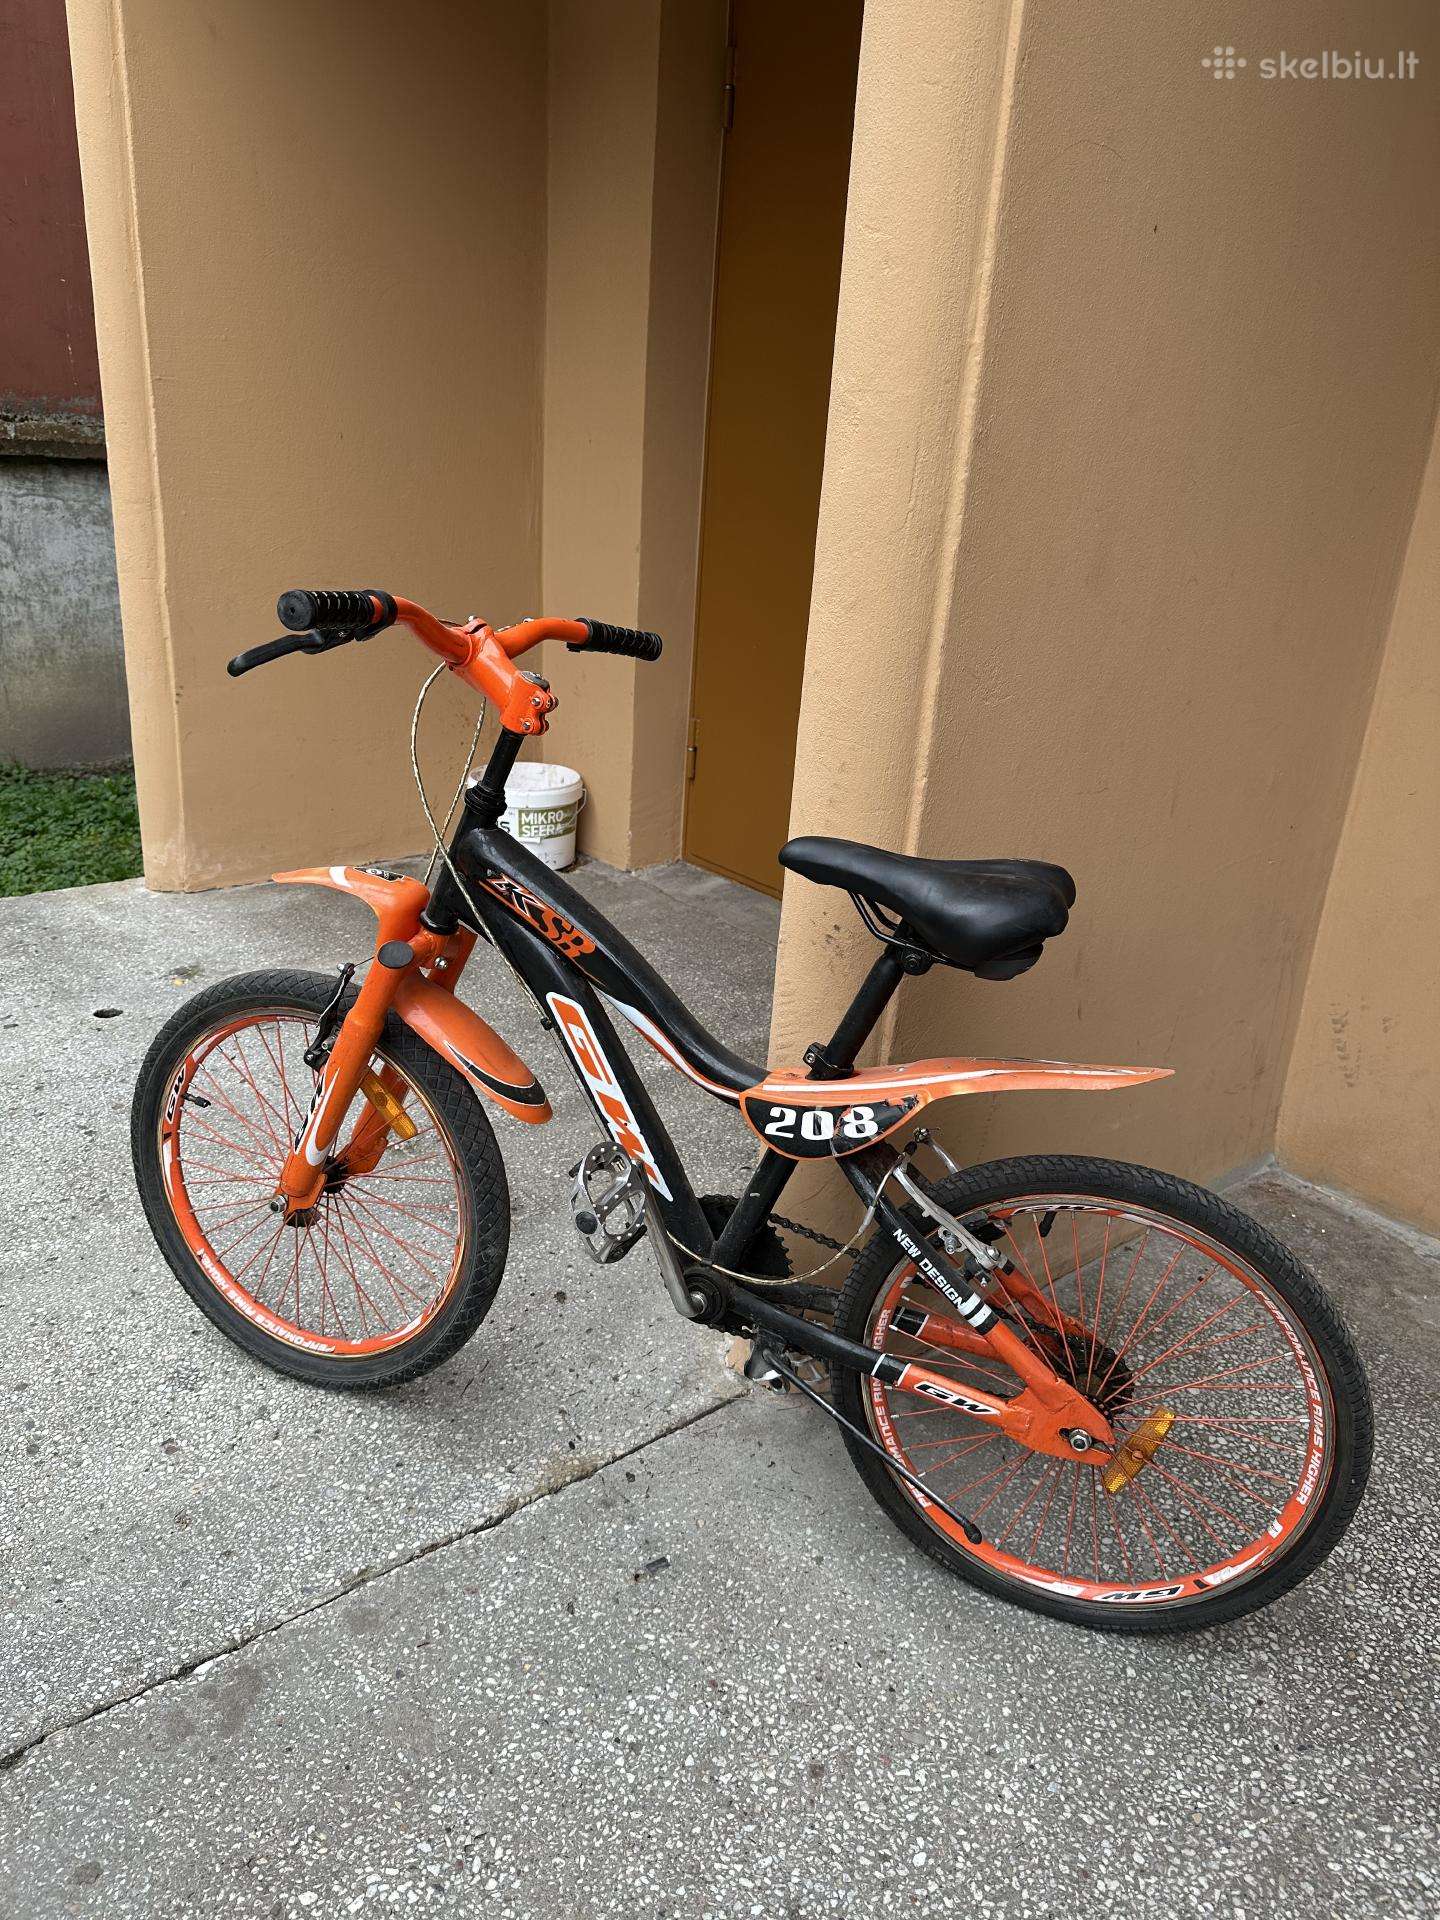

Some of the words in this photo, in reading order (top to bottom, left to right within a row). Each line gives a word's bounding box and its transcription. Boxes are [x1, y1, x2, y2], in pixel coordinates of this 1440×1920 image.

[764, 1106, 879, 1141] 208
[893, 1228, 922, 1258] NEW
[919, 1257, 967, 1310] DESIGN
[873, 1308, 892, 1350] IGHER
[914, 1382, 998, 1414] GW
[1312, 1402, 1324, 1448] RIMS
[1296, 1449, 1321, 1505] HIGHER
